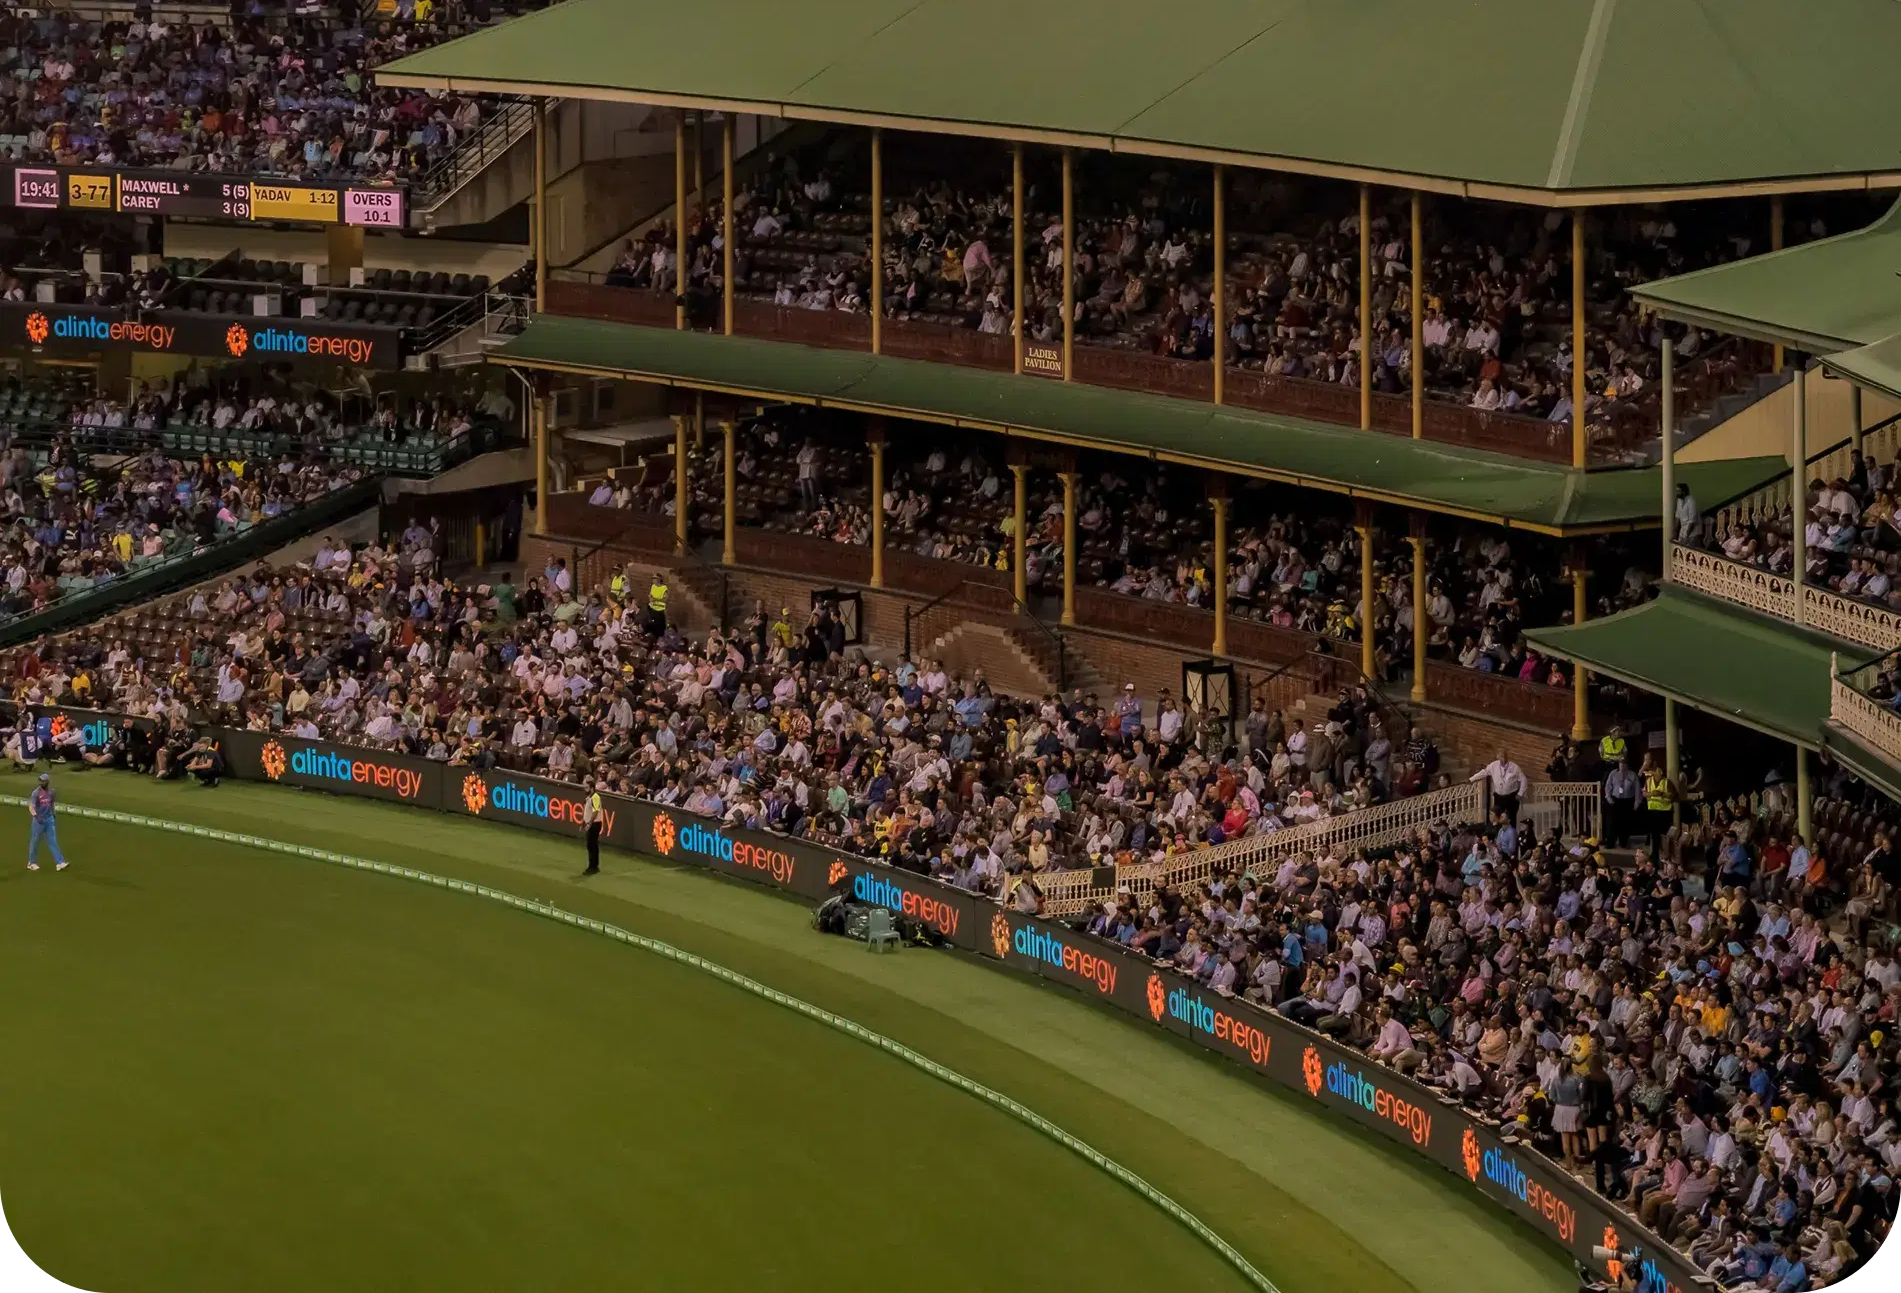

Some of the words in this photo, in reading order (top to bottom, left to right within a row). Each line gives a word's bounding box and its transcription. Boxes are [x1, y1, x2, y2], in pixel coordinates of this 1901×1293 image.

[21, 181, 59, 198] 19:41
[72, 184, 108, 201] 3-77
[121, 179, 180, 195] MAXWELL
[222, 184, 231, 196] 5
[233, 184, 250, 200] (5)
[254, 188, 291, 201] YADAV
[309, 192, 336, 204] 1-12
[121, 195, 160, 209] CAREY
[222, 202, 231, 214] 3
[233, 202, 250, 218] (3)
[352, 193, 392, 206] OVERS
[364, 210, 391, 223] 10.1
[1029, 347, 1058, 360] LADIES
[1024, 357, 1062, 371] PAVILION
